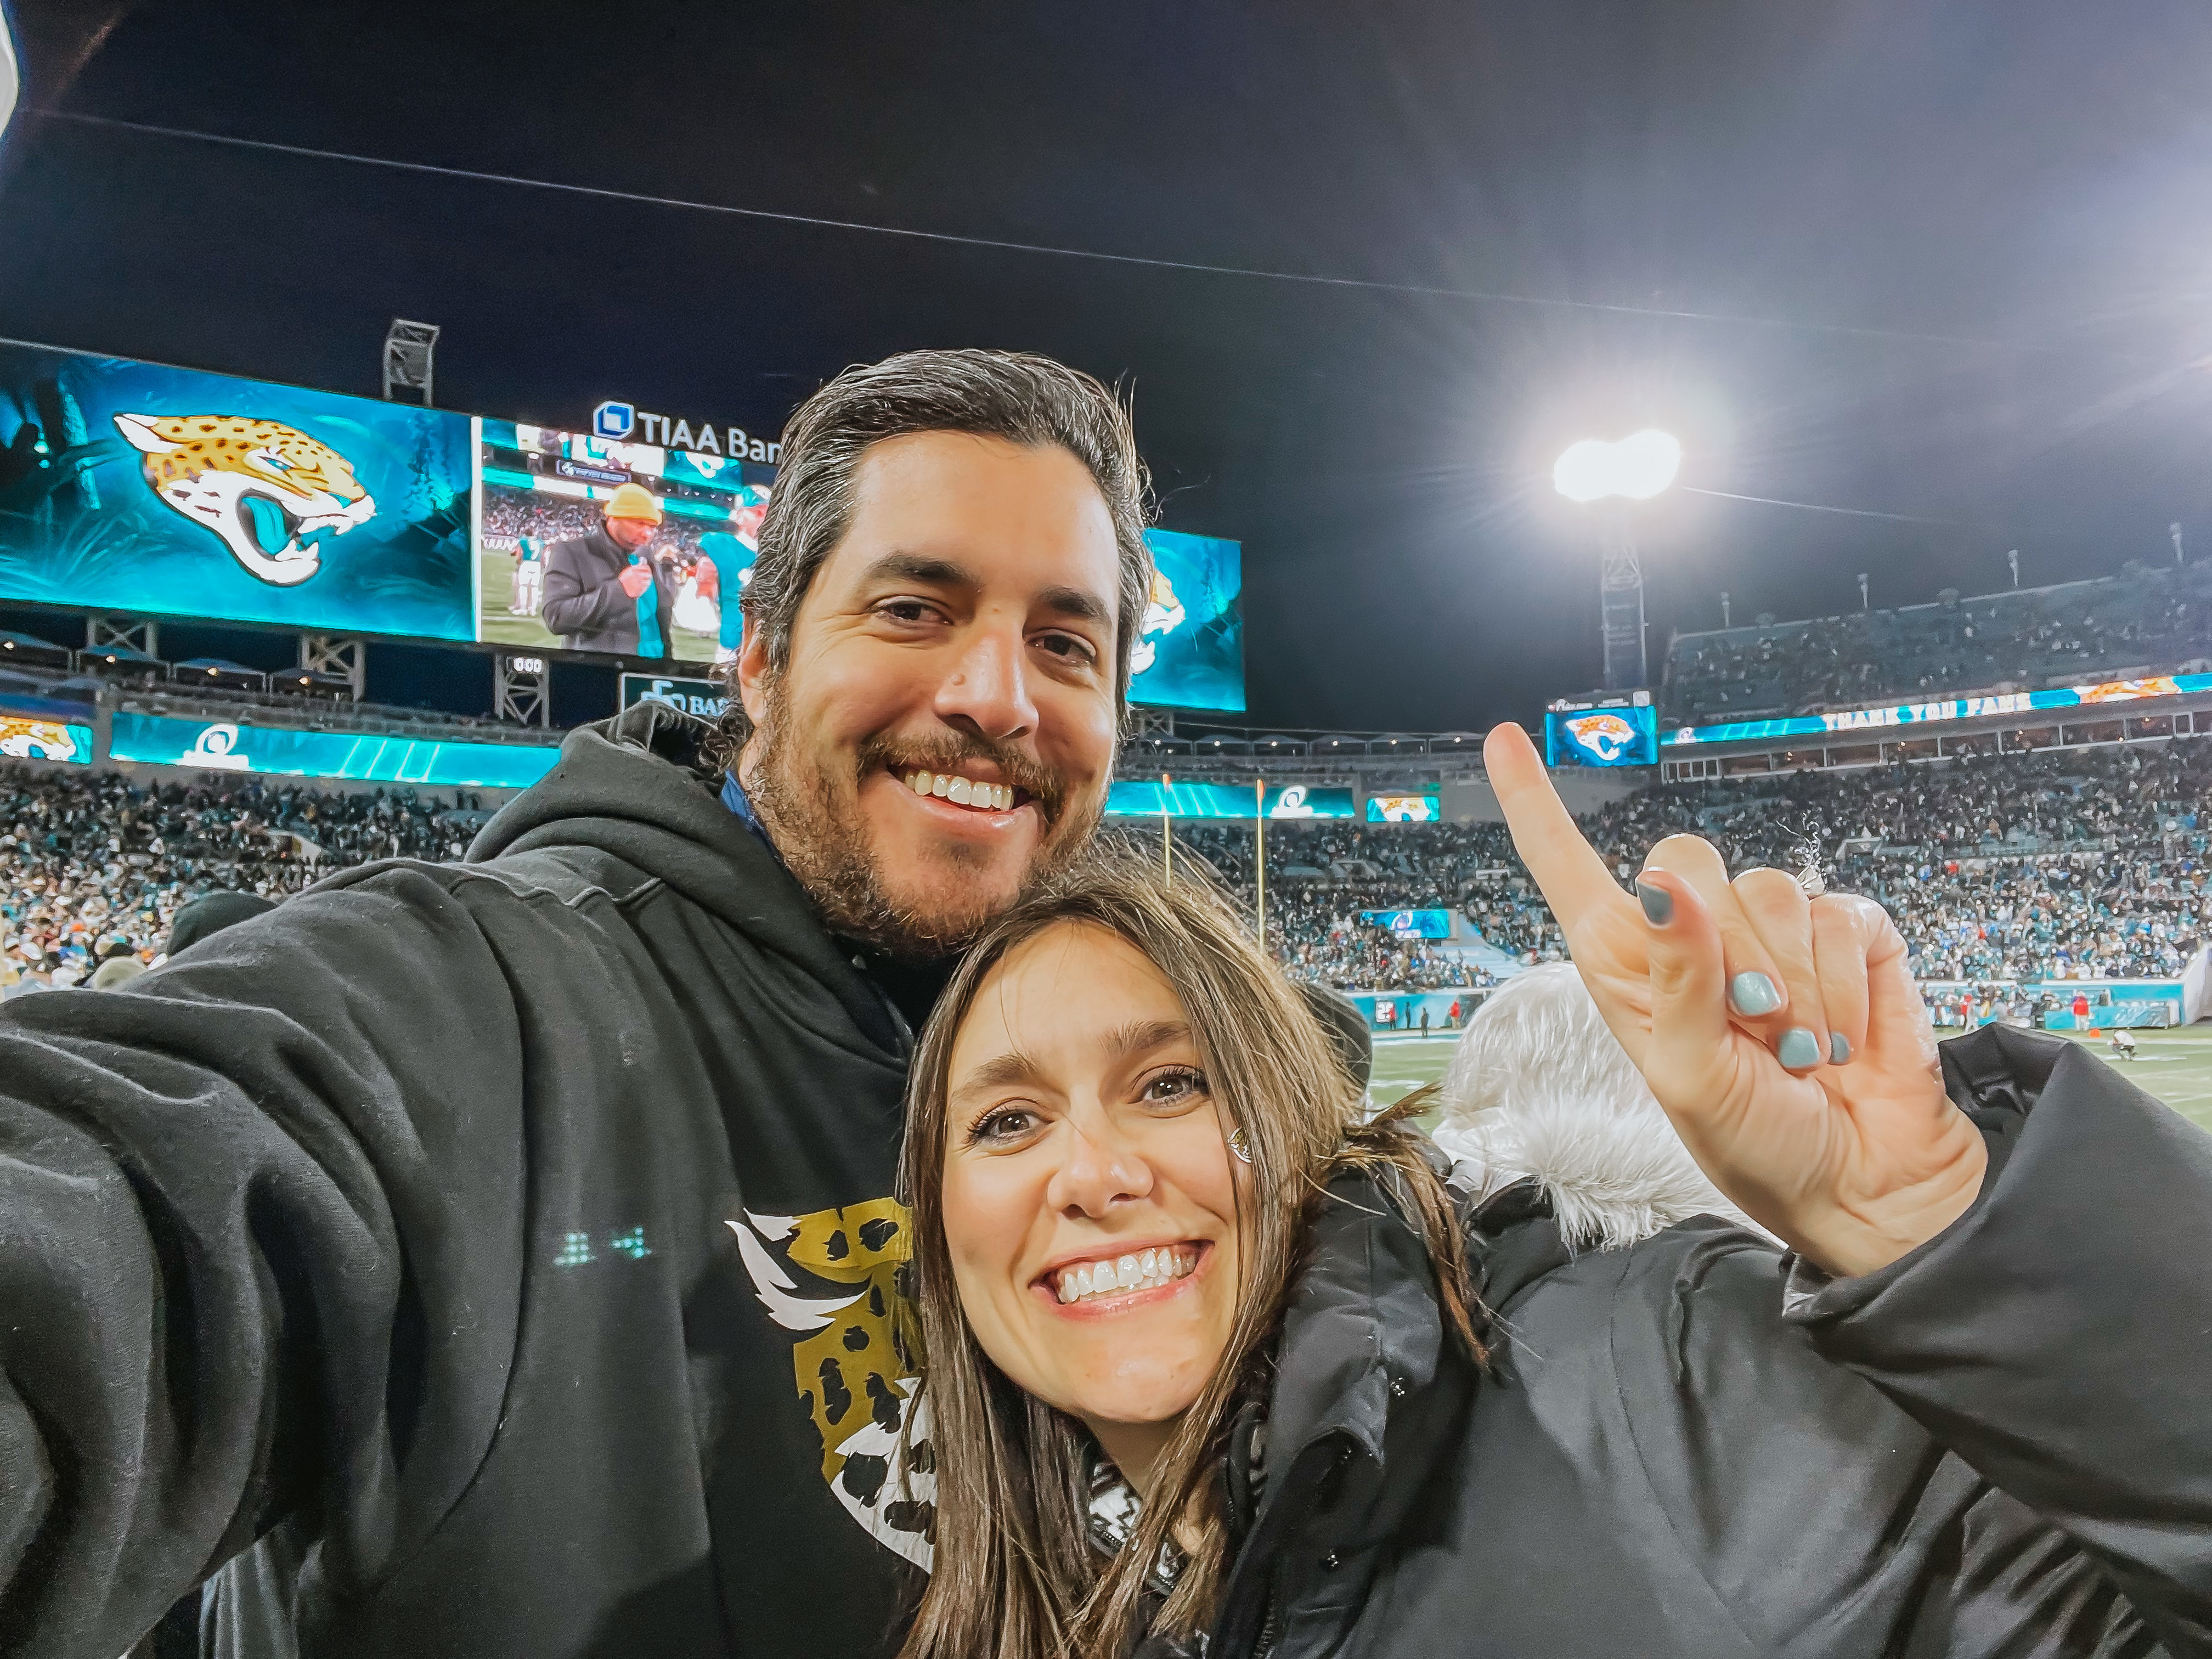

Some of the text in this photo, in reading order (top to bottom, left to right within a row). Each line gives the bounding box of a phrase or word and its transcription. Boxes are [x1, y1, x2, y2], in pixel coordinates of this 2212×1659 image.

[637, 411, 720, 454] TIAA
[1822, 692, 2032, 731] THANK YOU FANS
